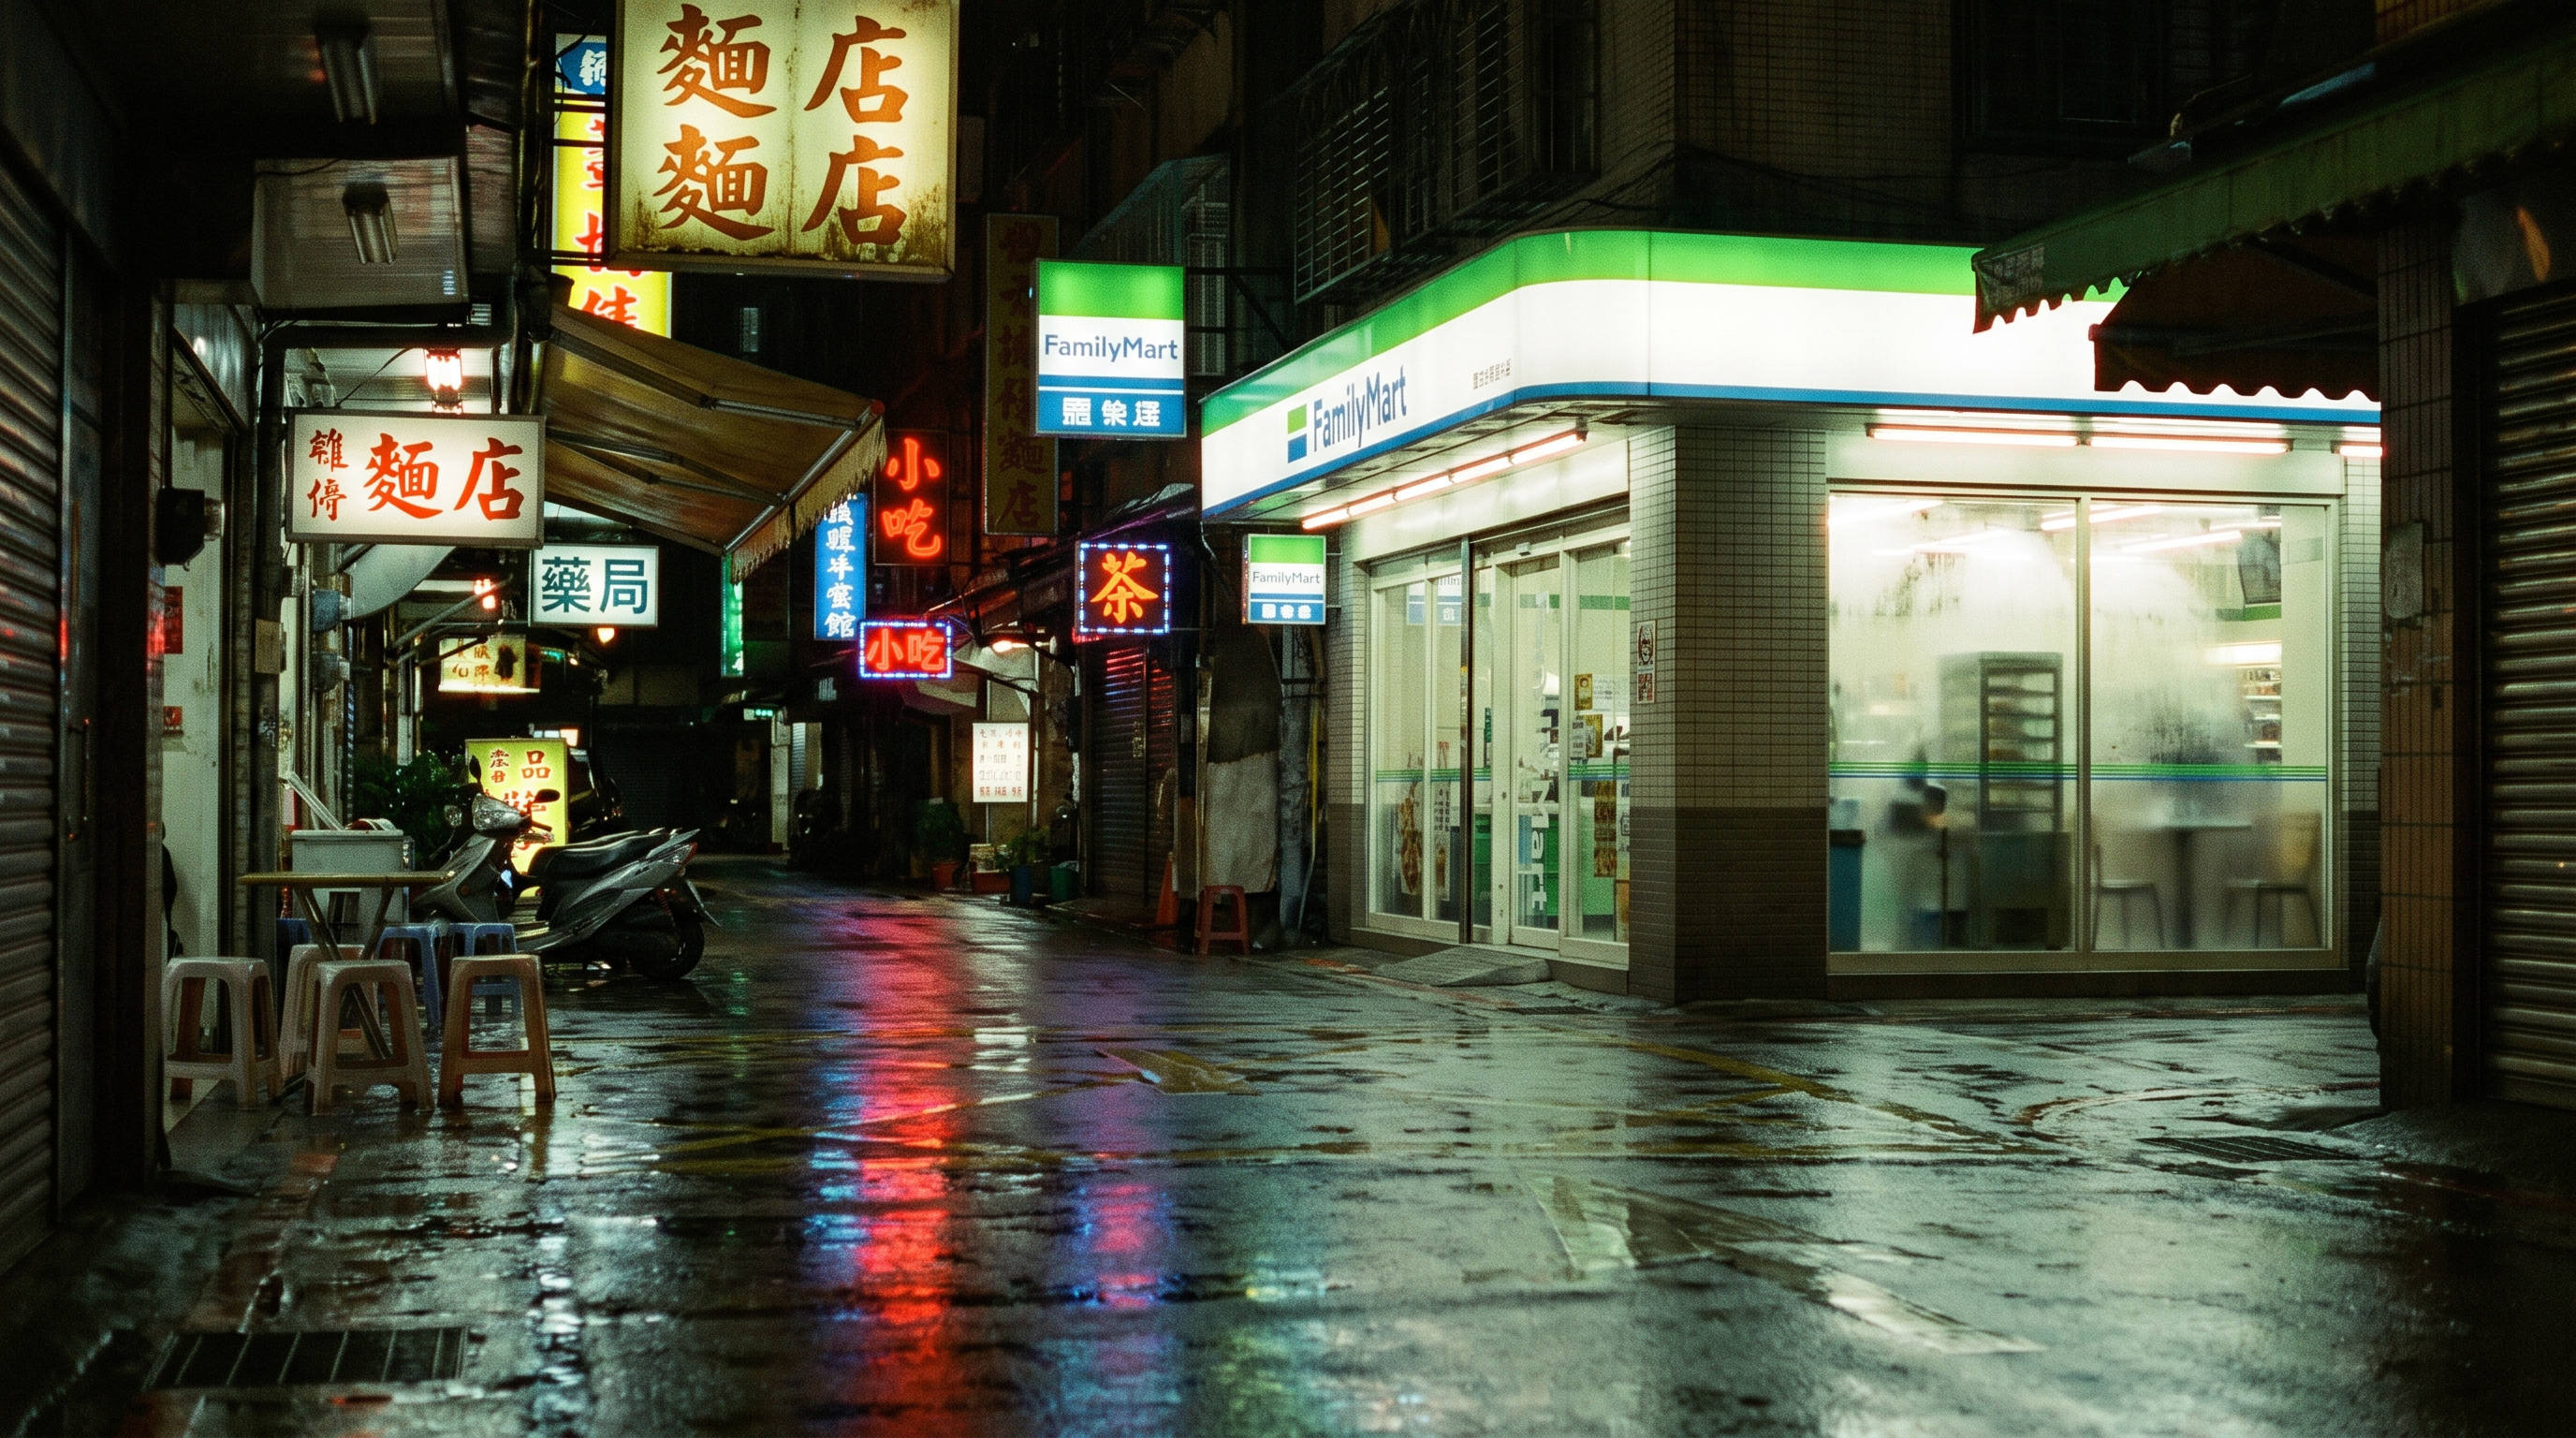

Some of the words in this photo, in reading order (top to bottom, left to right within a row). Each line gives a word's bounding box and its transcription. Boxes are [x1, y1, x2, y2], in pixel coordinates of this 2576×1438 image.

[656, 3, 907, 124] 麵店
[652, 124, 907, 245] 麵店
[1045, 334, 1178, 363] FamilyMart
[1313, 364, 1407, 452] FamilyMart
[362, 433, 525, 521] 麵店
[881, 436, 942, 557] 小吃
[541, 556, 649, 614] 藥局
[1090, 551, 1159, 624] 茶
[1252, 571, 1321, 586] FamilyMart
[867, 627, 945, 671] 小吃
